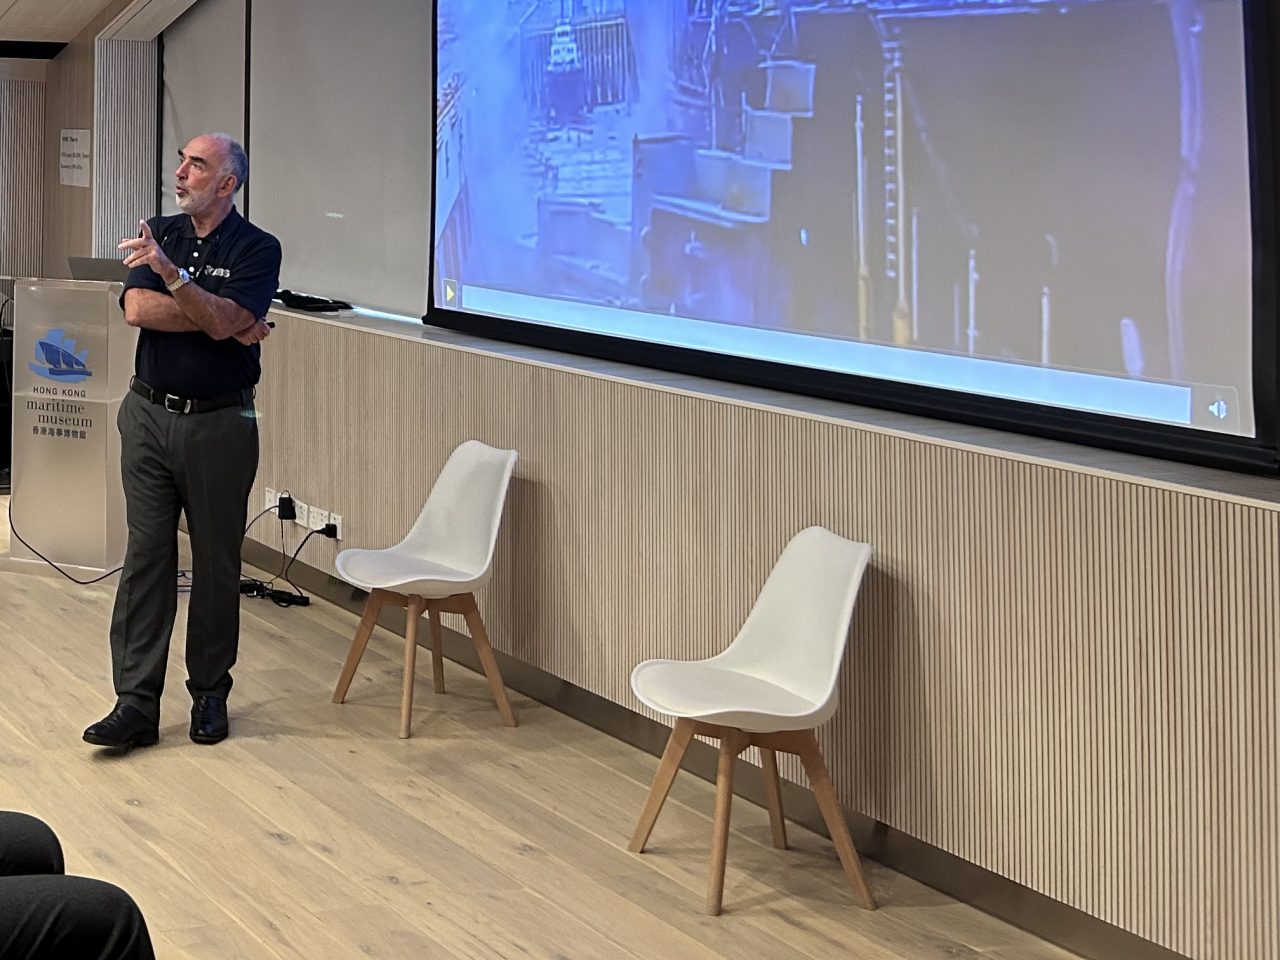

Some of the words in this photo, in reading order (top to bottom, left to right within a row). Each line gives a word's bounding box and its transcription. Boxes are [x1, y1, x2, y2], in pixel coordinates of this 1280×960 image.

[211, 267, 231, 278] ABS
[33, 386, 57, 395] HONG
[61, 389, 86, 398] KONG
[27, 399, 85, 414] maritime
[38, 414, 92, 427] museum
